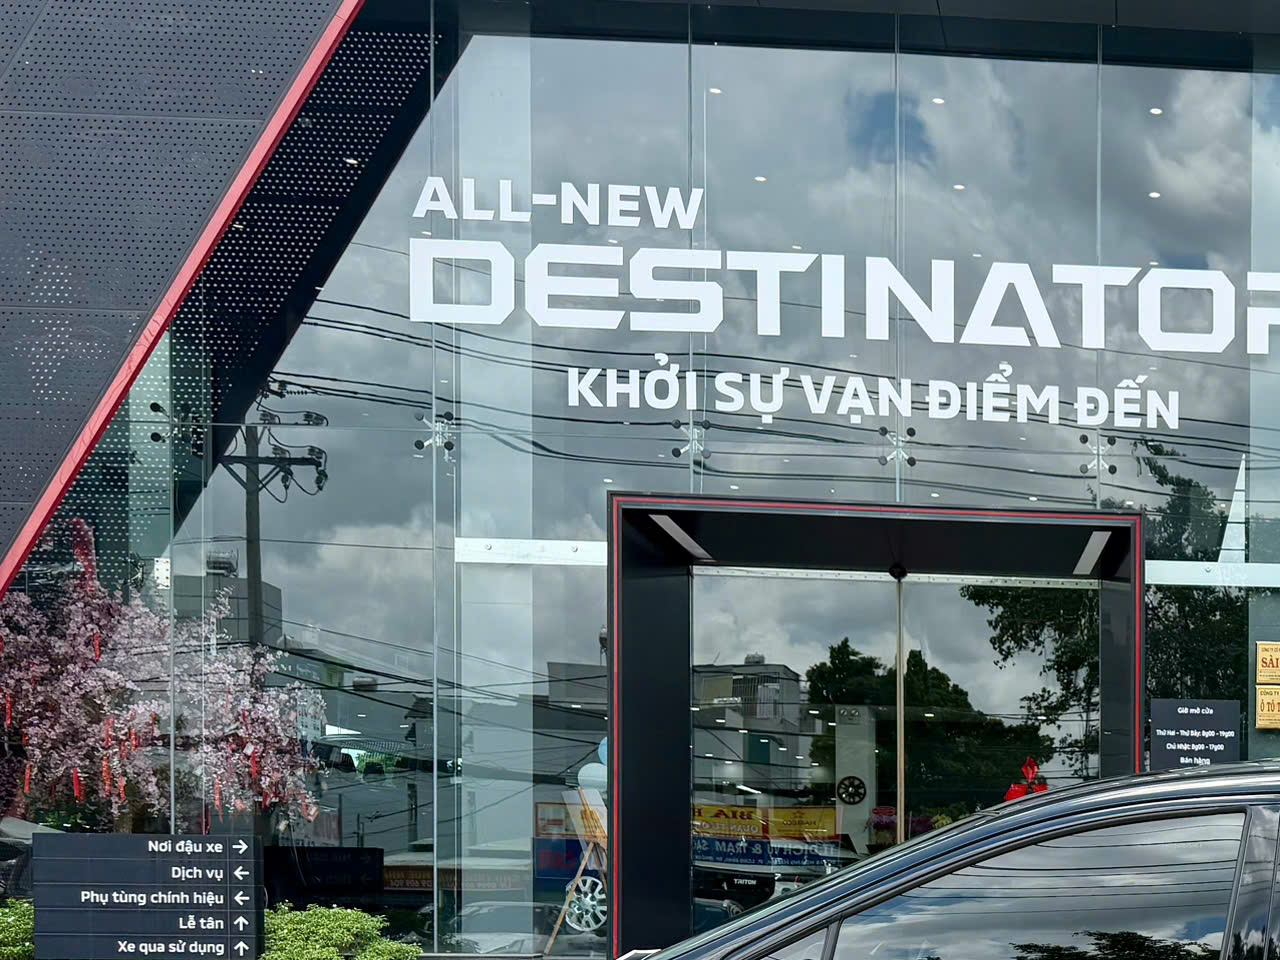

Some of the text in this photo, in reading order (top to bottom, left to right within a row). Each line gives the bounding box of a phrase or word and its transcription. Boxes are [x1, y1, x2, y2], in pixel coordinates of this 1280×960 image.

[411, 175, 705, 231] ALL-NEW
[567, 352, 1180, 430] KHỞI SỰ VẠN ĐIỂM ĐẾN
[1261, 655, 1279, 668] SÀI
[148, 839, 223, 854] Nơi đậu xe
[171, 866, 224, 882] Dịch vụ
[81, 890, 224, 906] Phụ tùng chính hiệu
[179, 914, 224, 930] Lễ tân
[117, 939, 225, 956] Xe qua sử dụng
